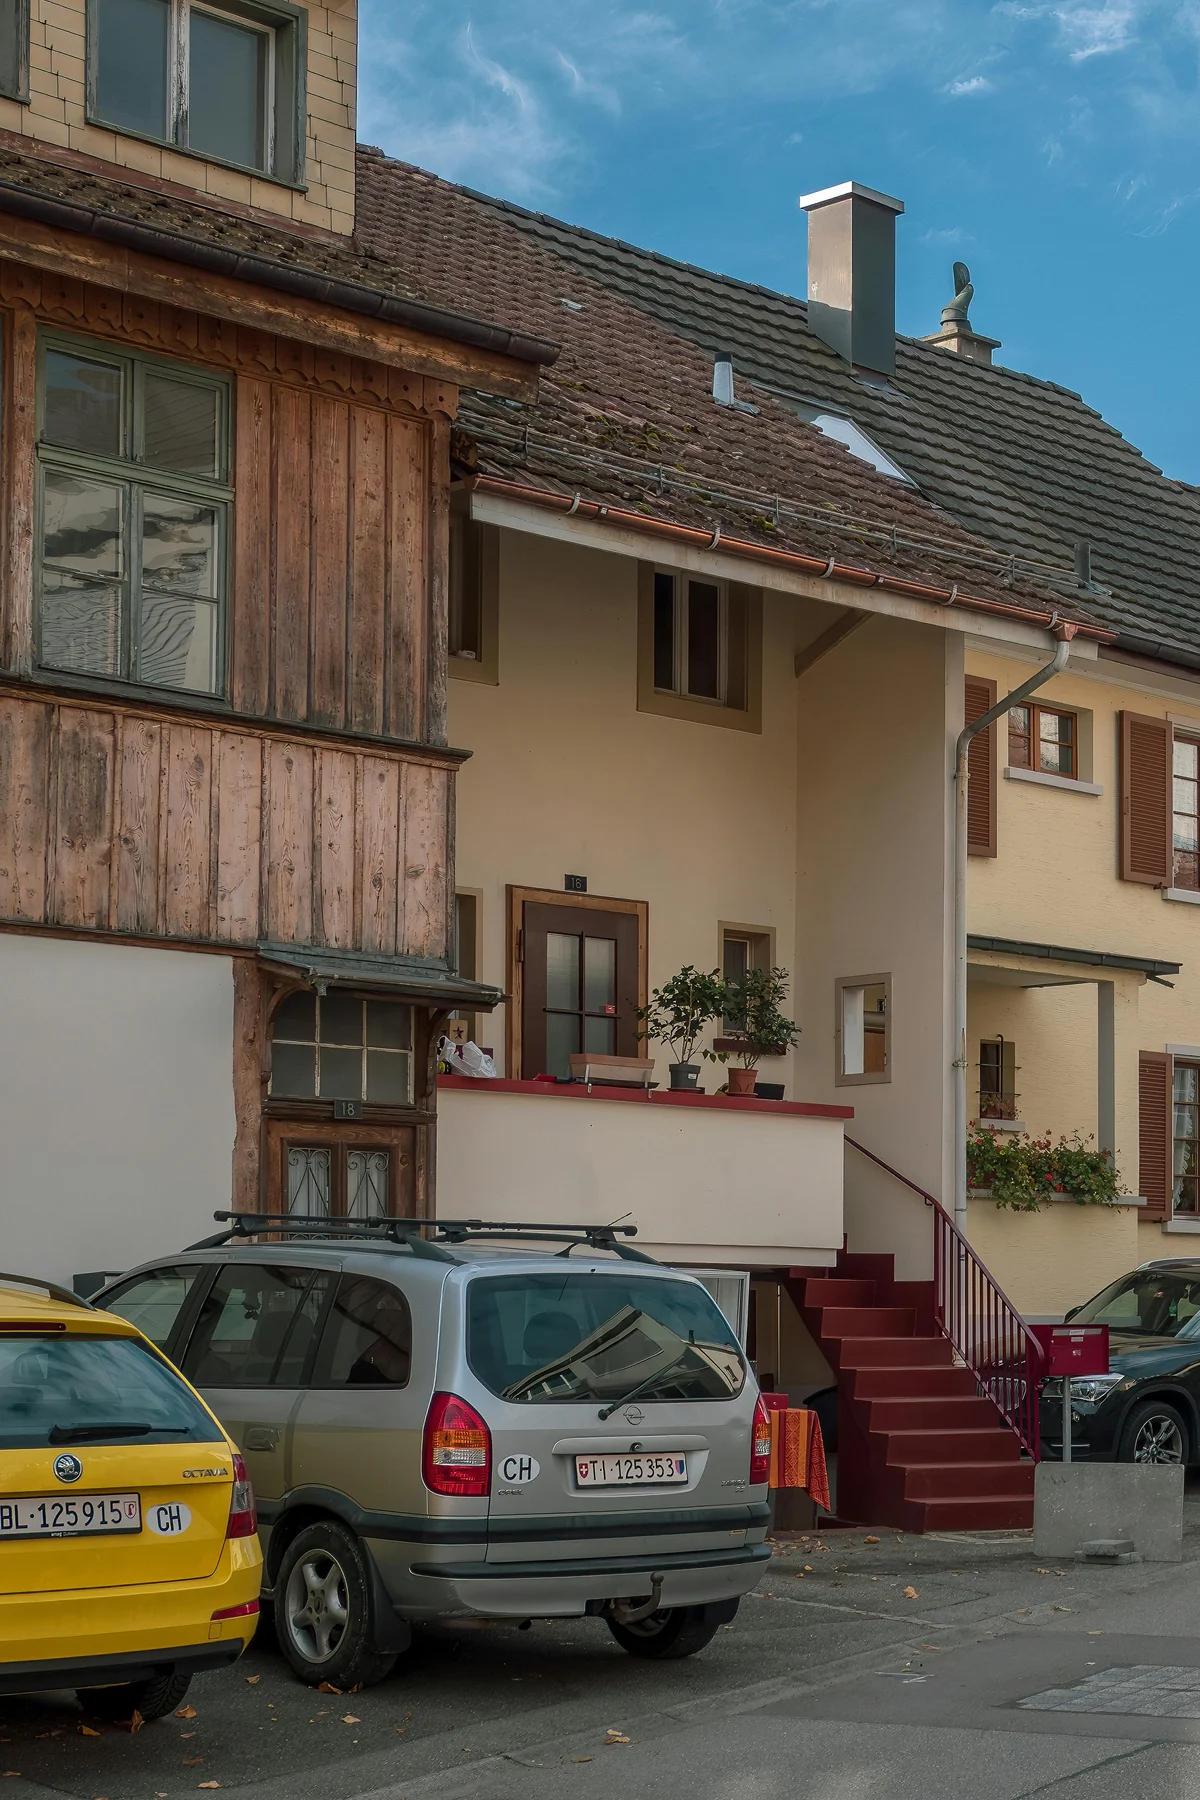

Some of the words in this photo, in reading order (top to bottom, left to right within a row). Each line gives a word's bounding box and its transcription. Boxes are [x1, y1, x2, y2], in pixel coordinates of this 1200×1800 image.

[571, 877, 582, 889] 16
[342, 1102, 355, 1116] 18
[182, 1468, 229, 1479] OCTAVIA
[503, 1457, 532, 1481] CH
[156, 1505, 182, 1532] CH
